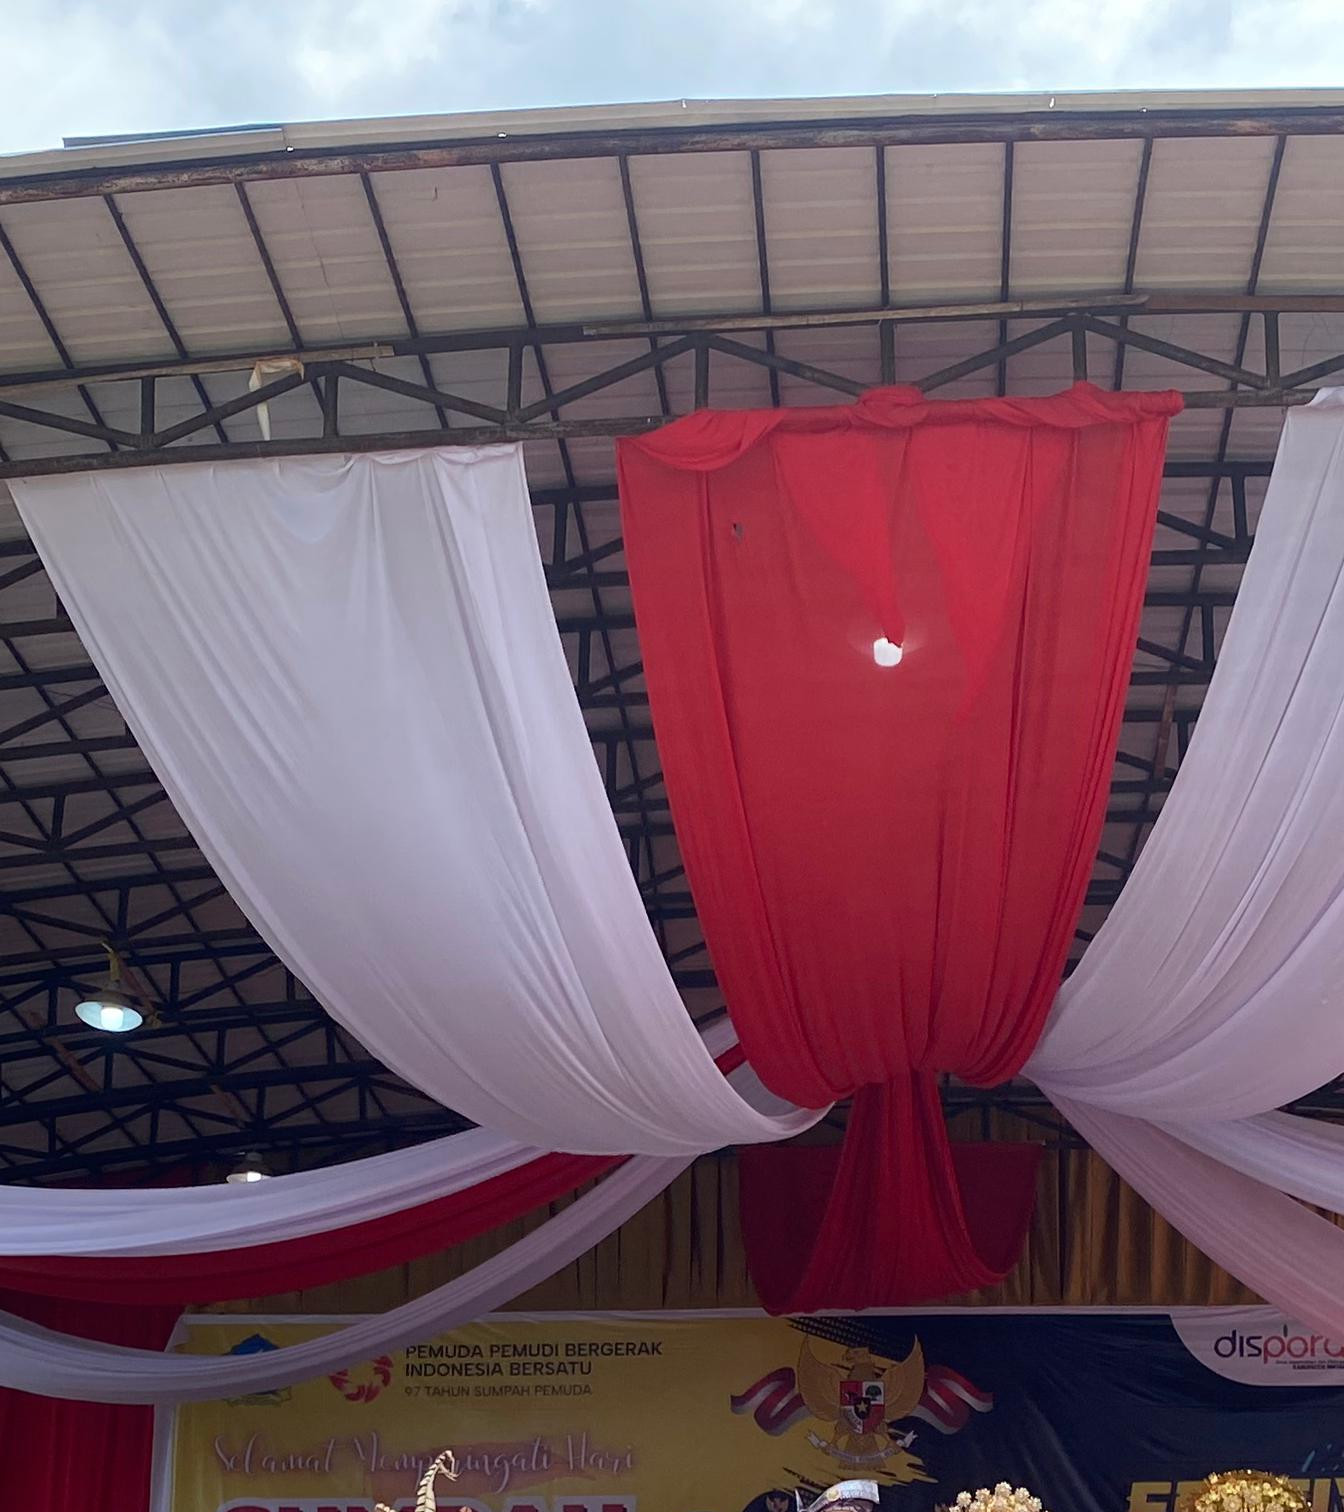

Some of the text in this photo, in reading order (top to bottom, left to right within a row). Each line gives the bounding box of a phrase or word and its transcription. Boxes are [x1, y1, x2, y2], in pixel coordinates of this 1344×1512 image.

[406, 1342, 662, 1358] PEMUDA PEMUDI BERGERAK
[405, 1361, 592, 1376] INDONESIA BERSATU
[405, 1384, 592, 1397] 97 TAHUN SUMPAH PEMUDA
[214, 1432, 336, 1473] Selamat
[566, 1431, 635, 1475] Hari
